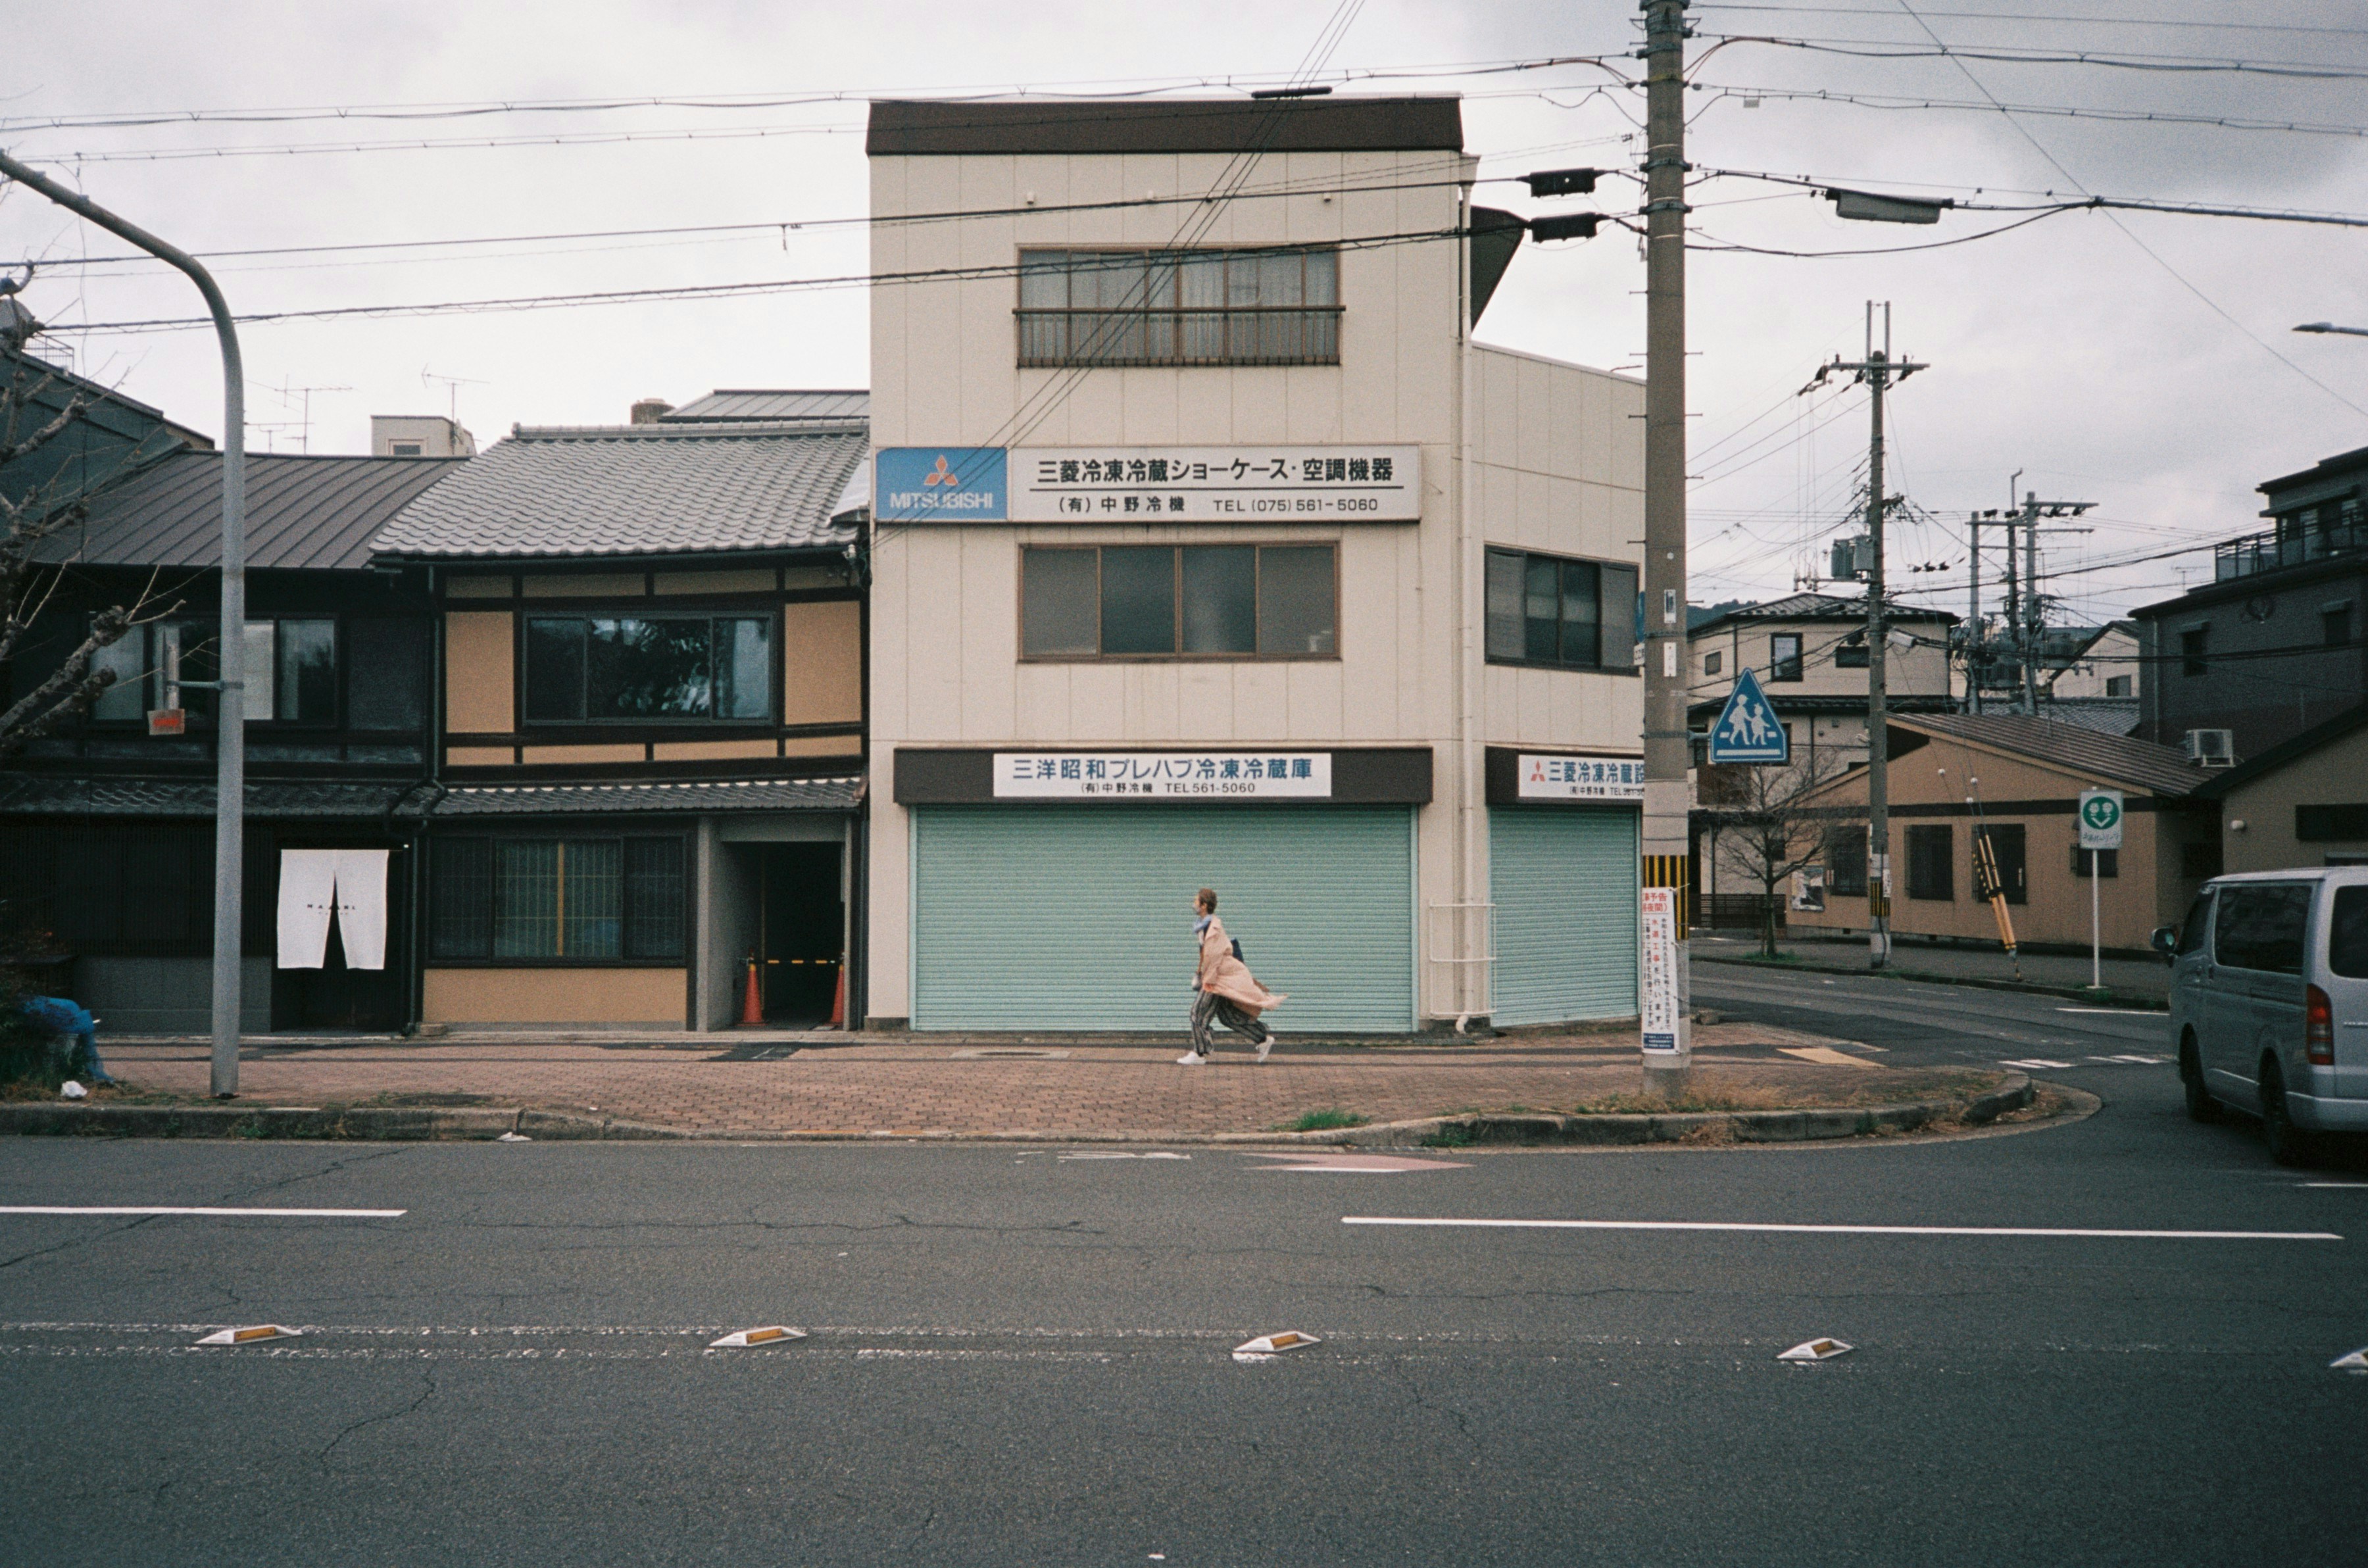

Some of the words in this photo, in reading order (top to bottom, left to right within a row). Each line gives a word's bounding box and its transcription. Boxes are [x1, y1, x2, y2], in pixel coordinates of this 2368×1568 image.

[890, 492, 993, 508] MITSUBISHI
[1213, 500, 1245, 512] TEL
[1013, 758, 1312, 779] 三洋昭和プレハブ冷凍冷蔵庫
